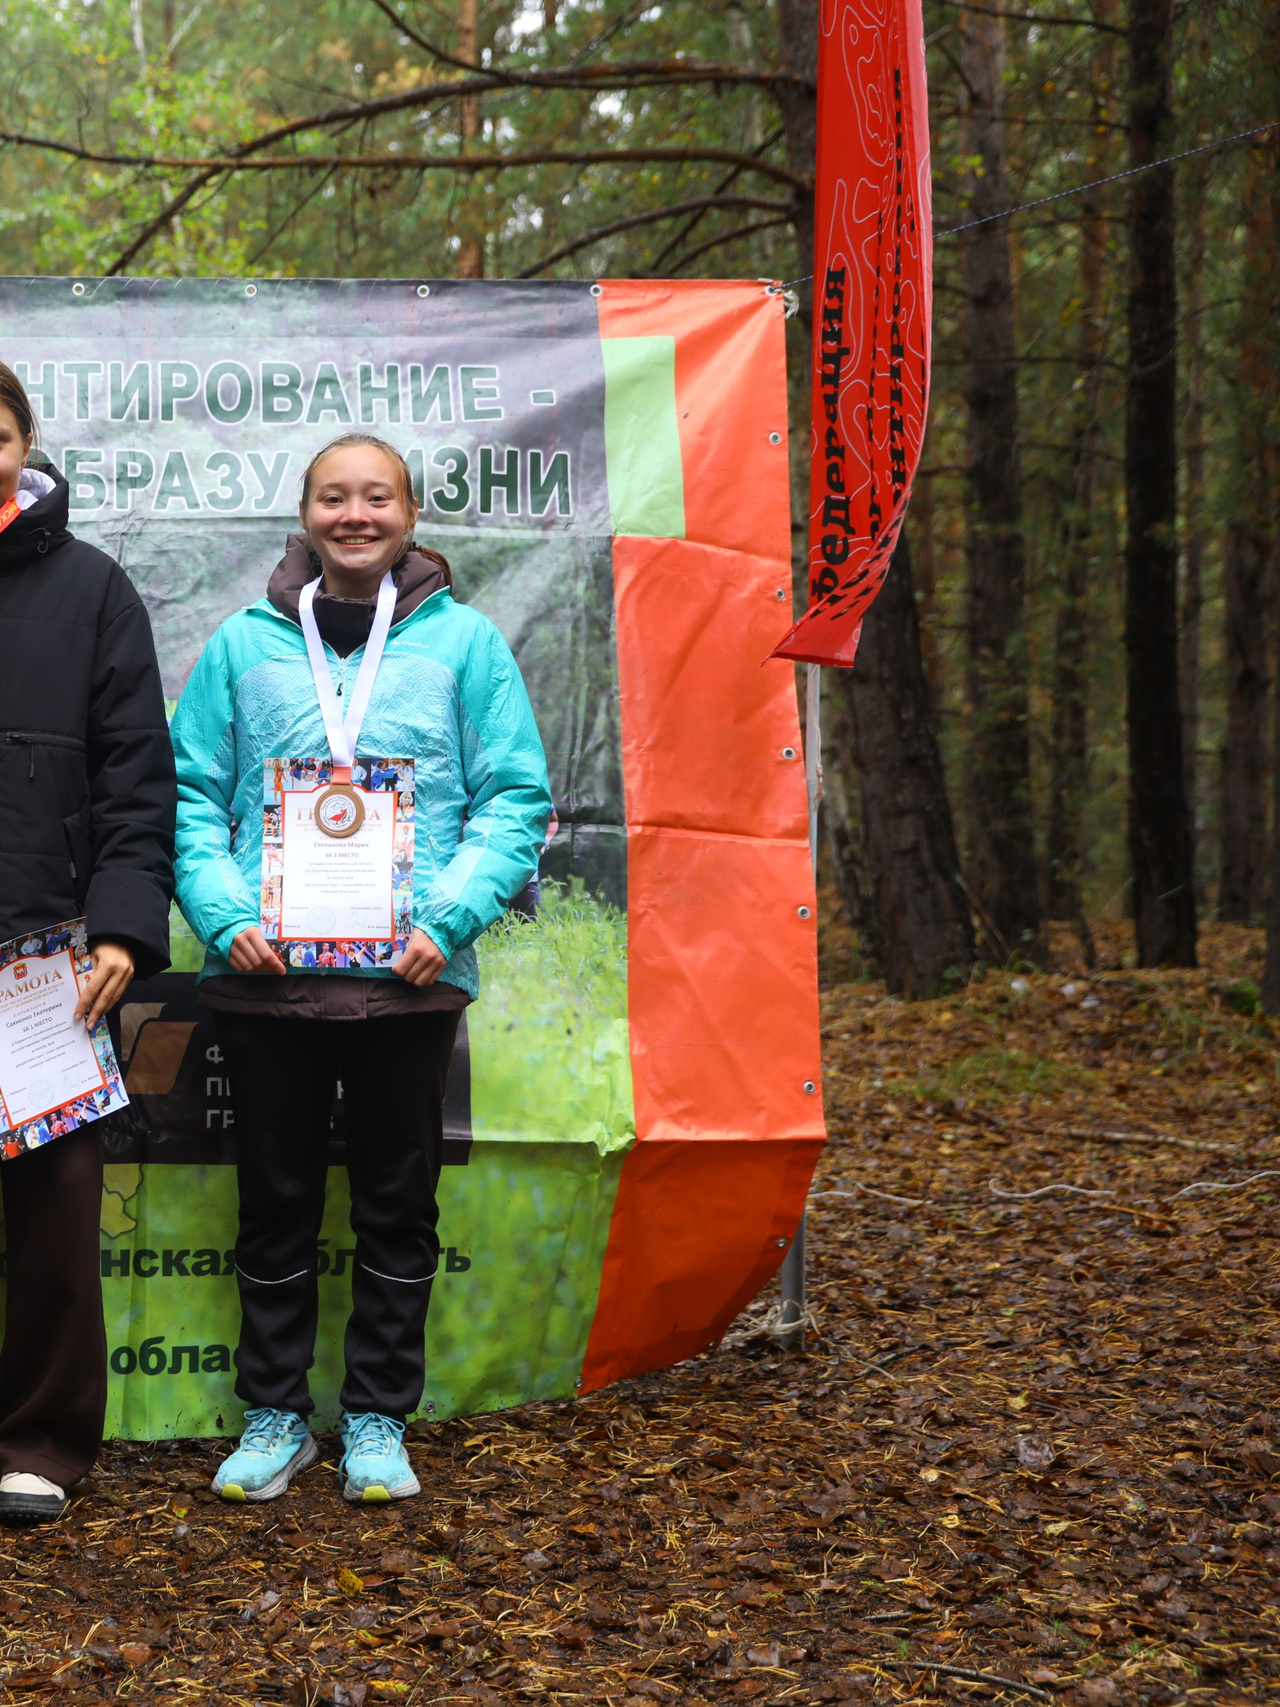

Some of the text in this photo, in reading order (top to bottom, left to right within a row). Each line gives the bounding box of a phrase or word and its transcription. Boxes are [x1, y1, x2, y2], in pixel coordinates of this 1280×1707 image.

[28, 446, 290, 513] БРАЗУ
[404, 447, 571, 516] ИЗНИ
[110, 1336, 239, 1375] обла
